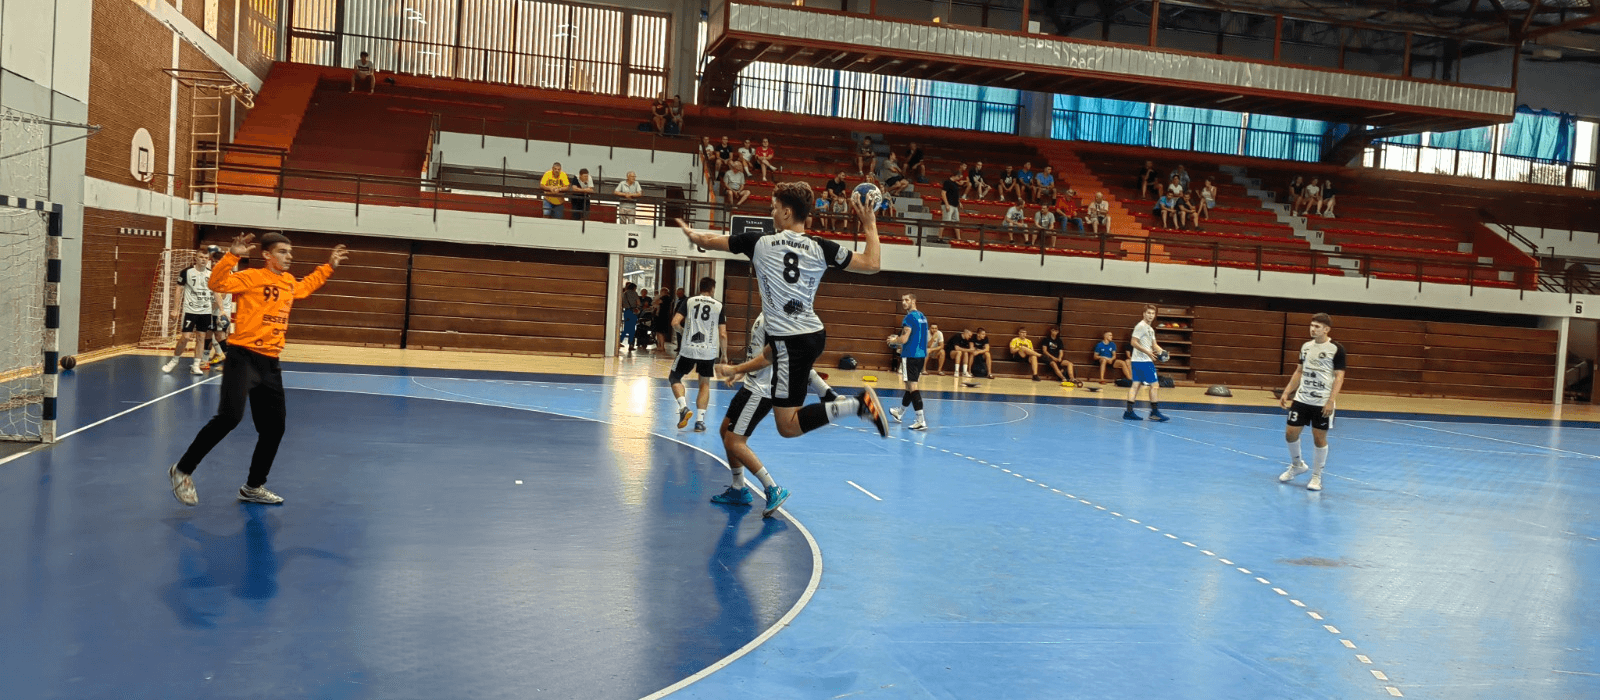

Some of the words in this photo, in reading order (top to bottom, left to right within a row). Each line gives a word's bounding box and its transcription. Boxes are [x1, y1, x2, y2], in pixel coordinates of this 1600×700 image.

[628, 238, 638, 248] D
[782, 252, 800, 284] 8
[263, 286, 279, 301] 99
[693, 303, 711, 321] 18
[1575, 305, 1583, 314] B
[185, 320, 192, 328] 7
[1304, 380, 1325, 388] artik
[1287, 410, 1298, 422] 13
